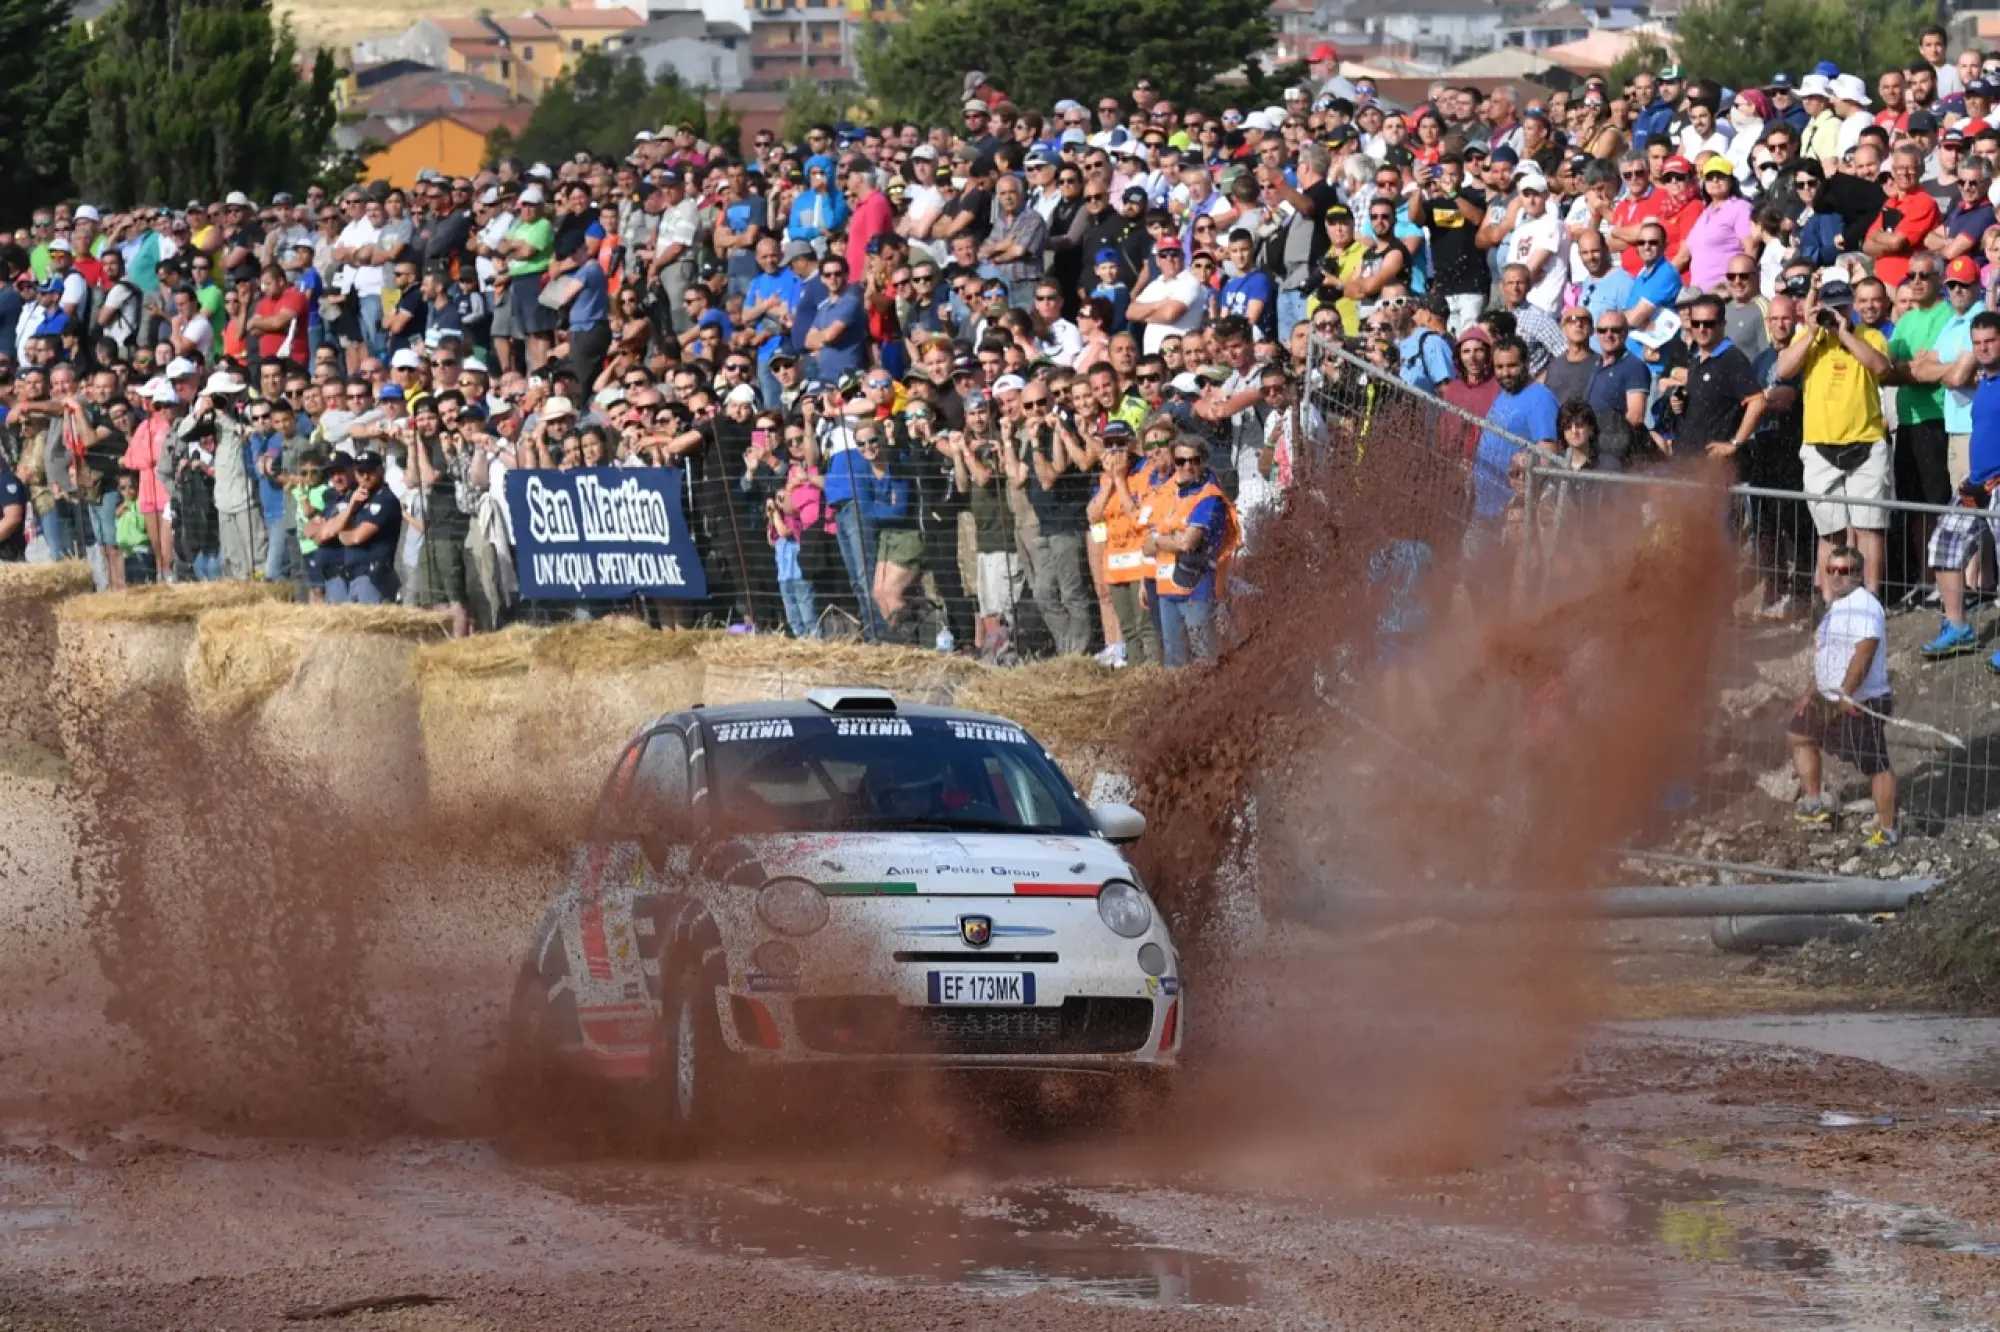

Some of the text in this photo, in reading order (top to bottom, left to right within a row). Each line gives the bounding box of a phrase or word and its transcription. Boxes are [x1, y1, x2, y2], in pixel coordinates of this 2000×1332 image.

[526, 475, 670, 545] San Martino
[717, 725, 794, 742] SELENIA
[837, 722, 913, 736] SELENIA
[954, 727, 1028, 745] SELENIA
[991, 865, 1040, 878] Group
[944, 976, 1020, 1000] EF 173MK
